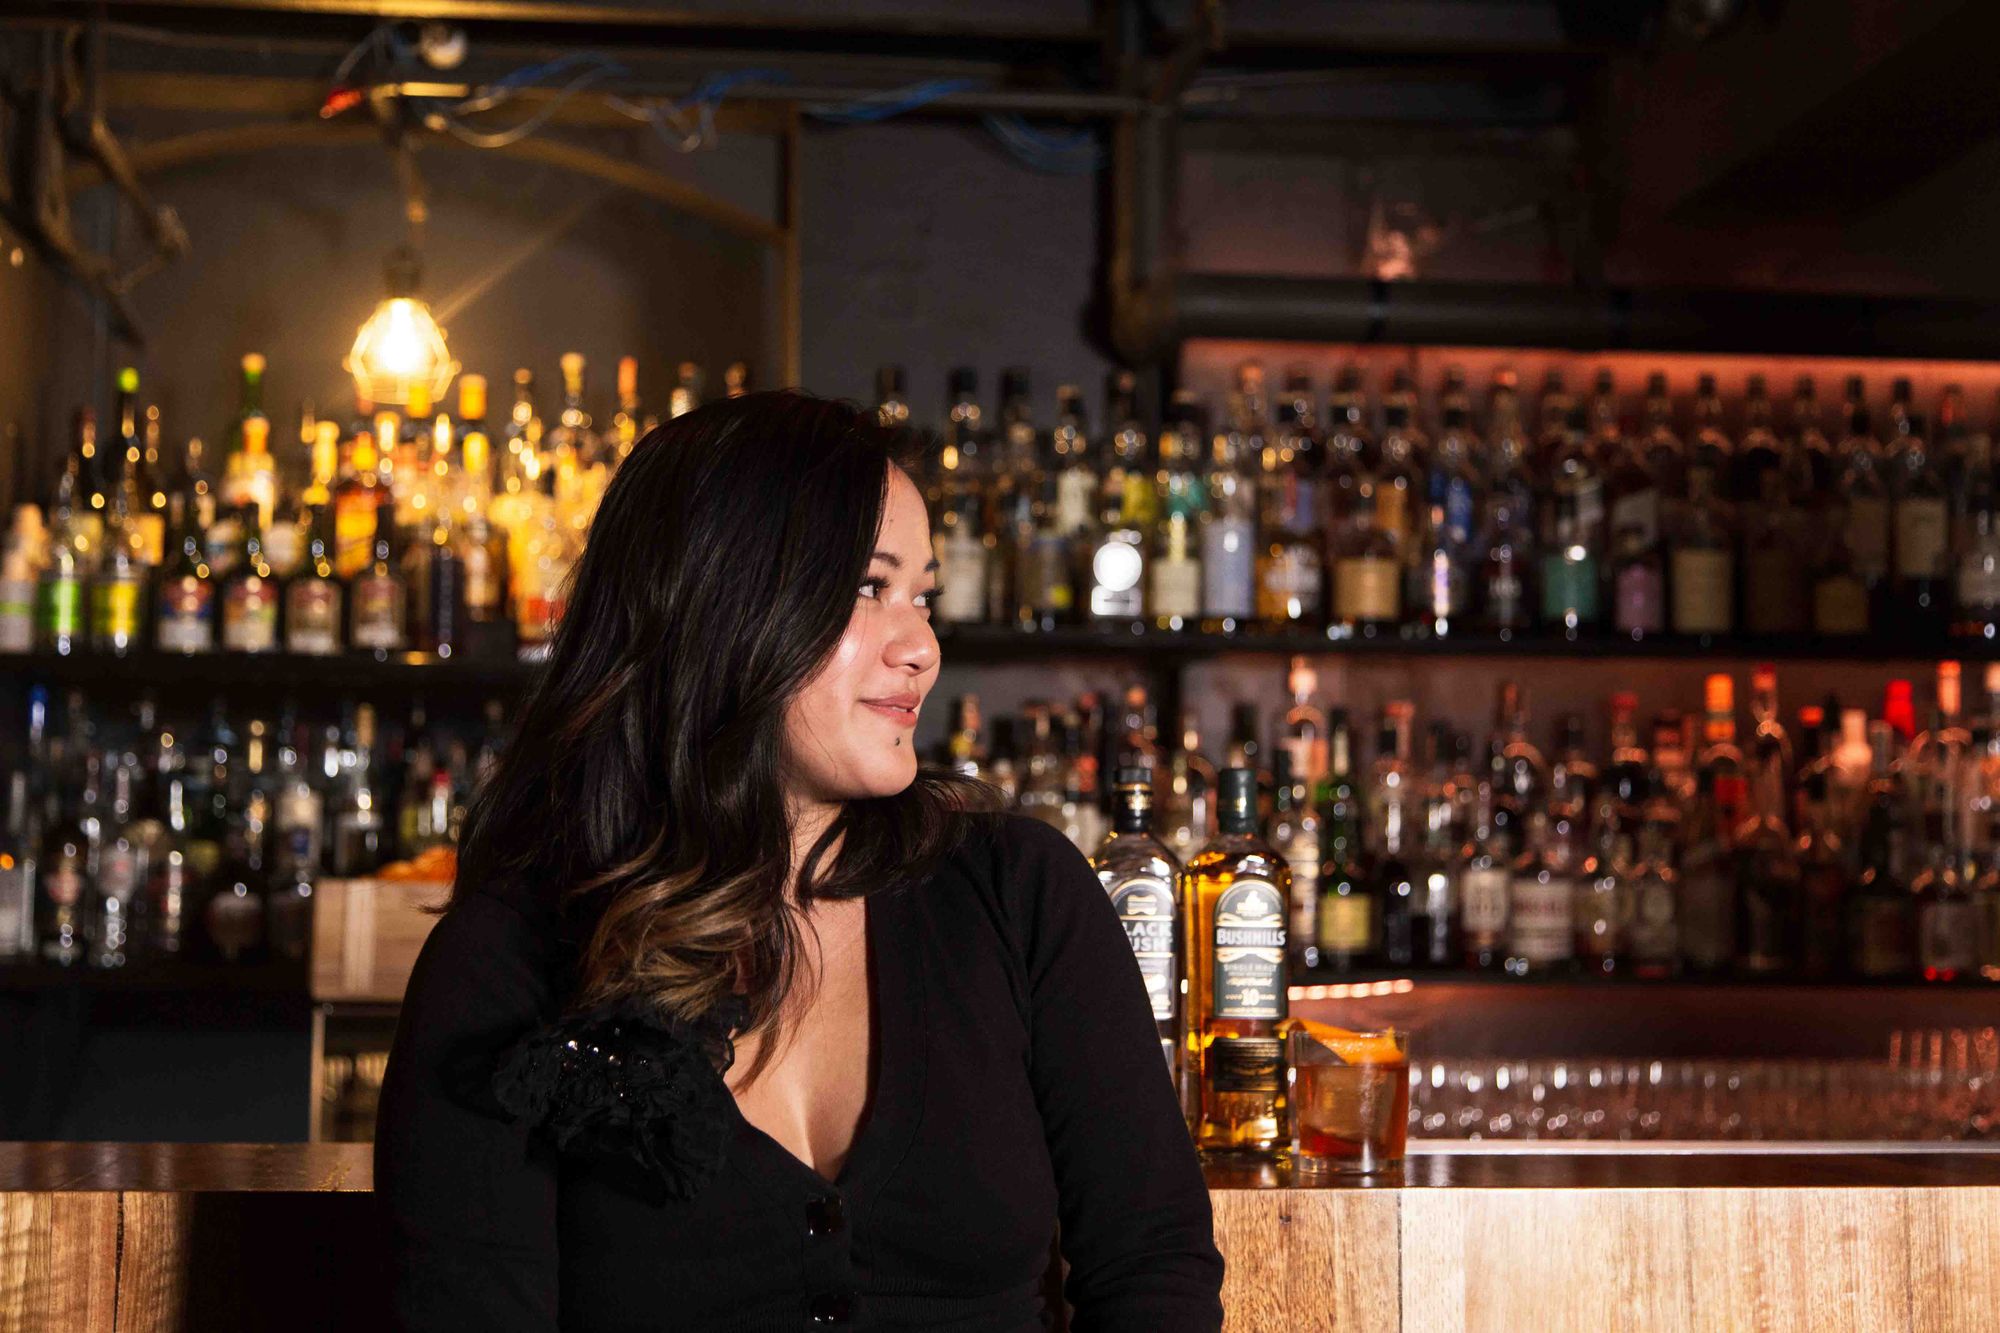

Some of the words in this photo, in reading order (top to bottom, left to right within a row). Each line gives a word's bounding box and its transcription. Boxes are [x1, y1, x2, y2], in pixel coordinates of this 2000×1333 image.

[1122, 921, 1171, 937] LACK
[1216, 928, 1286, 946] BUSHMILLS
[1129, 937, 1167, 952] USH
[1241, 987, 1260, 1006] 10
